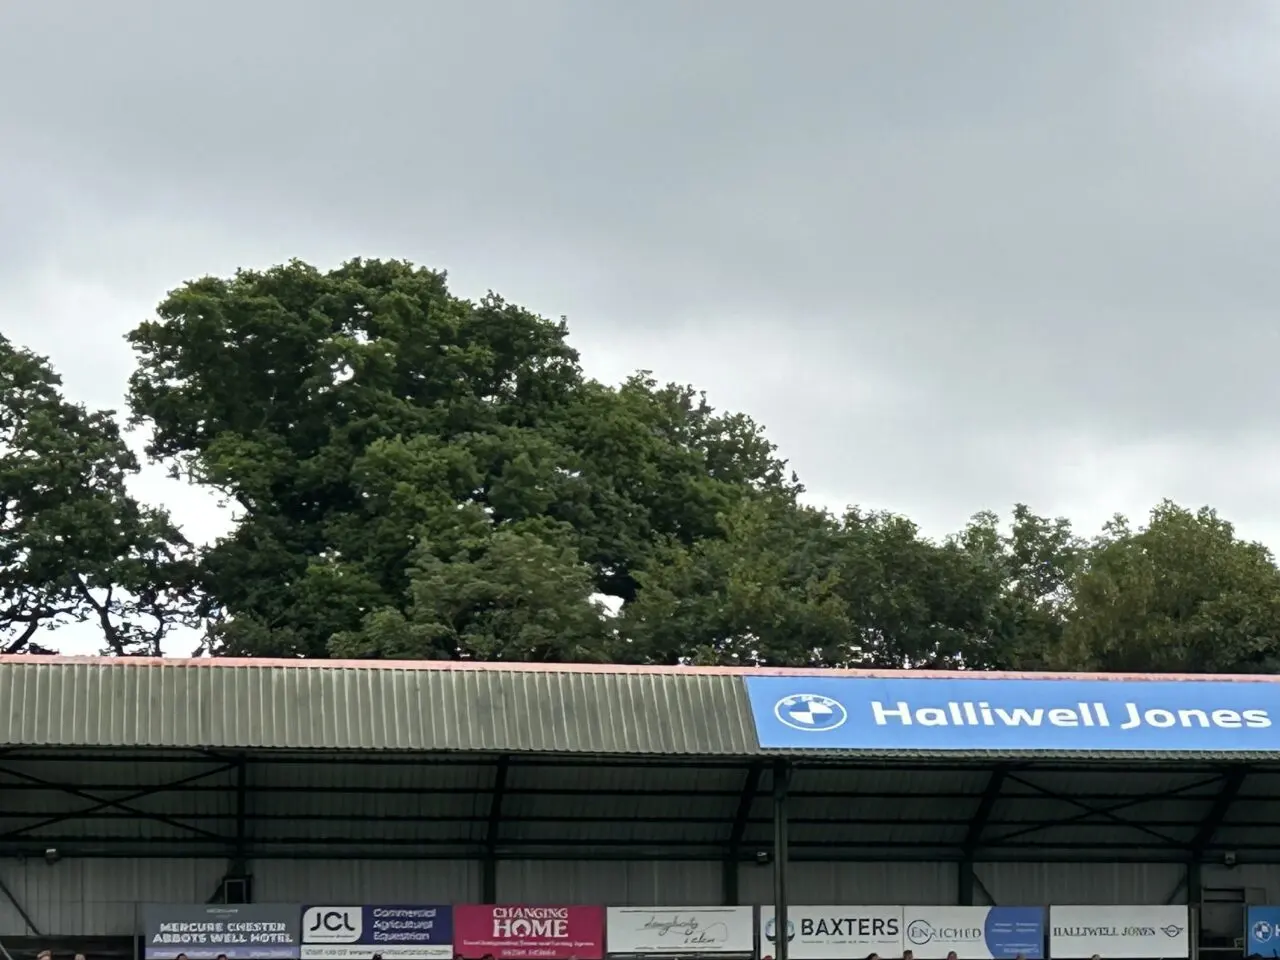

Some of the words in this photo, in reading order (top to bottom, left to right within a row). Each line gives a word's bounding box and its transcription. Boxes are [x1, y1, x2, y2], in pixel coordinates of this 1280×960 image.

[872, 701, 1109, 728] Halliwell
[1120, 702, 1272, 730] Jones
[493, 907, 568, 919] CHANGING
[160, 922, 223, 932] MERCURE
[227, 922, 286, 932] CHESTER
[310, 911, 356, 931] JCL
[493, 919, 568, 937] HOME
[801, 918, 899, 936] BAXTERS
[210, 933, 247, 943] WELL
[251, 933, 294, 943] HOTEL
[1053, 927, 1119, 937] HALLIWELL
[1121, 926, 1156, 937] JONES
